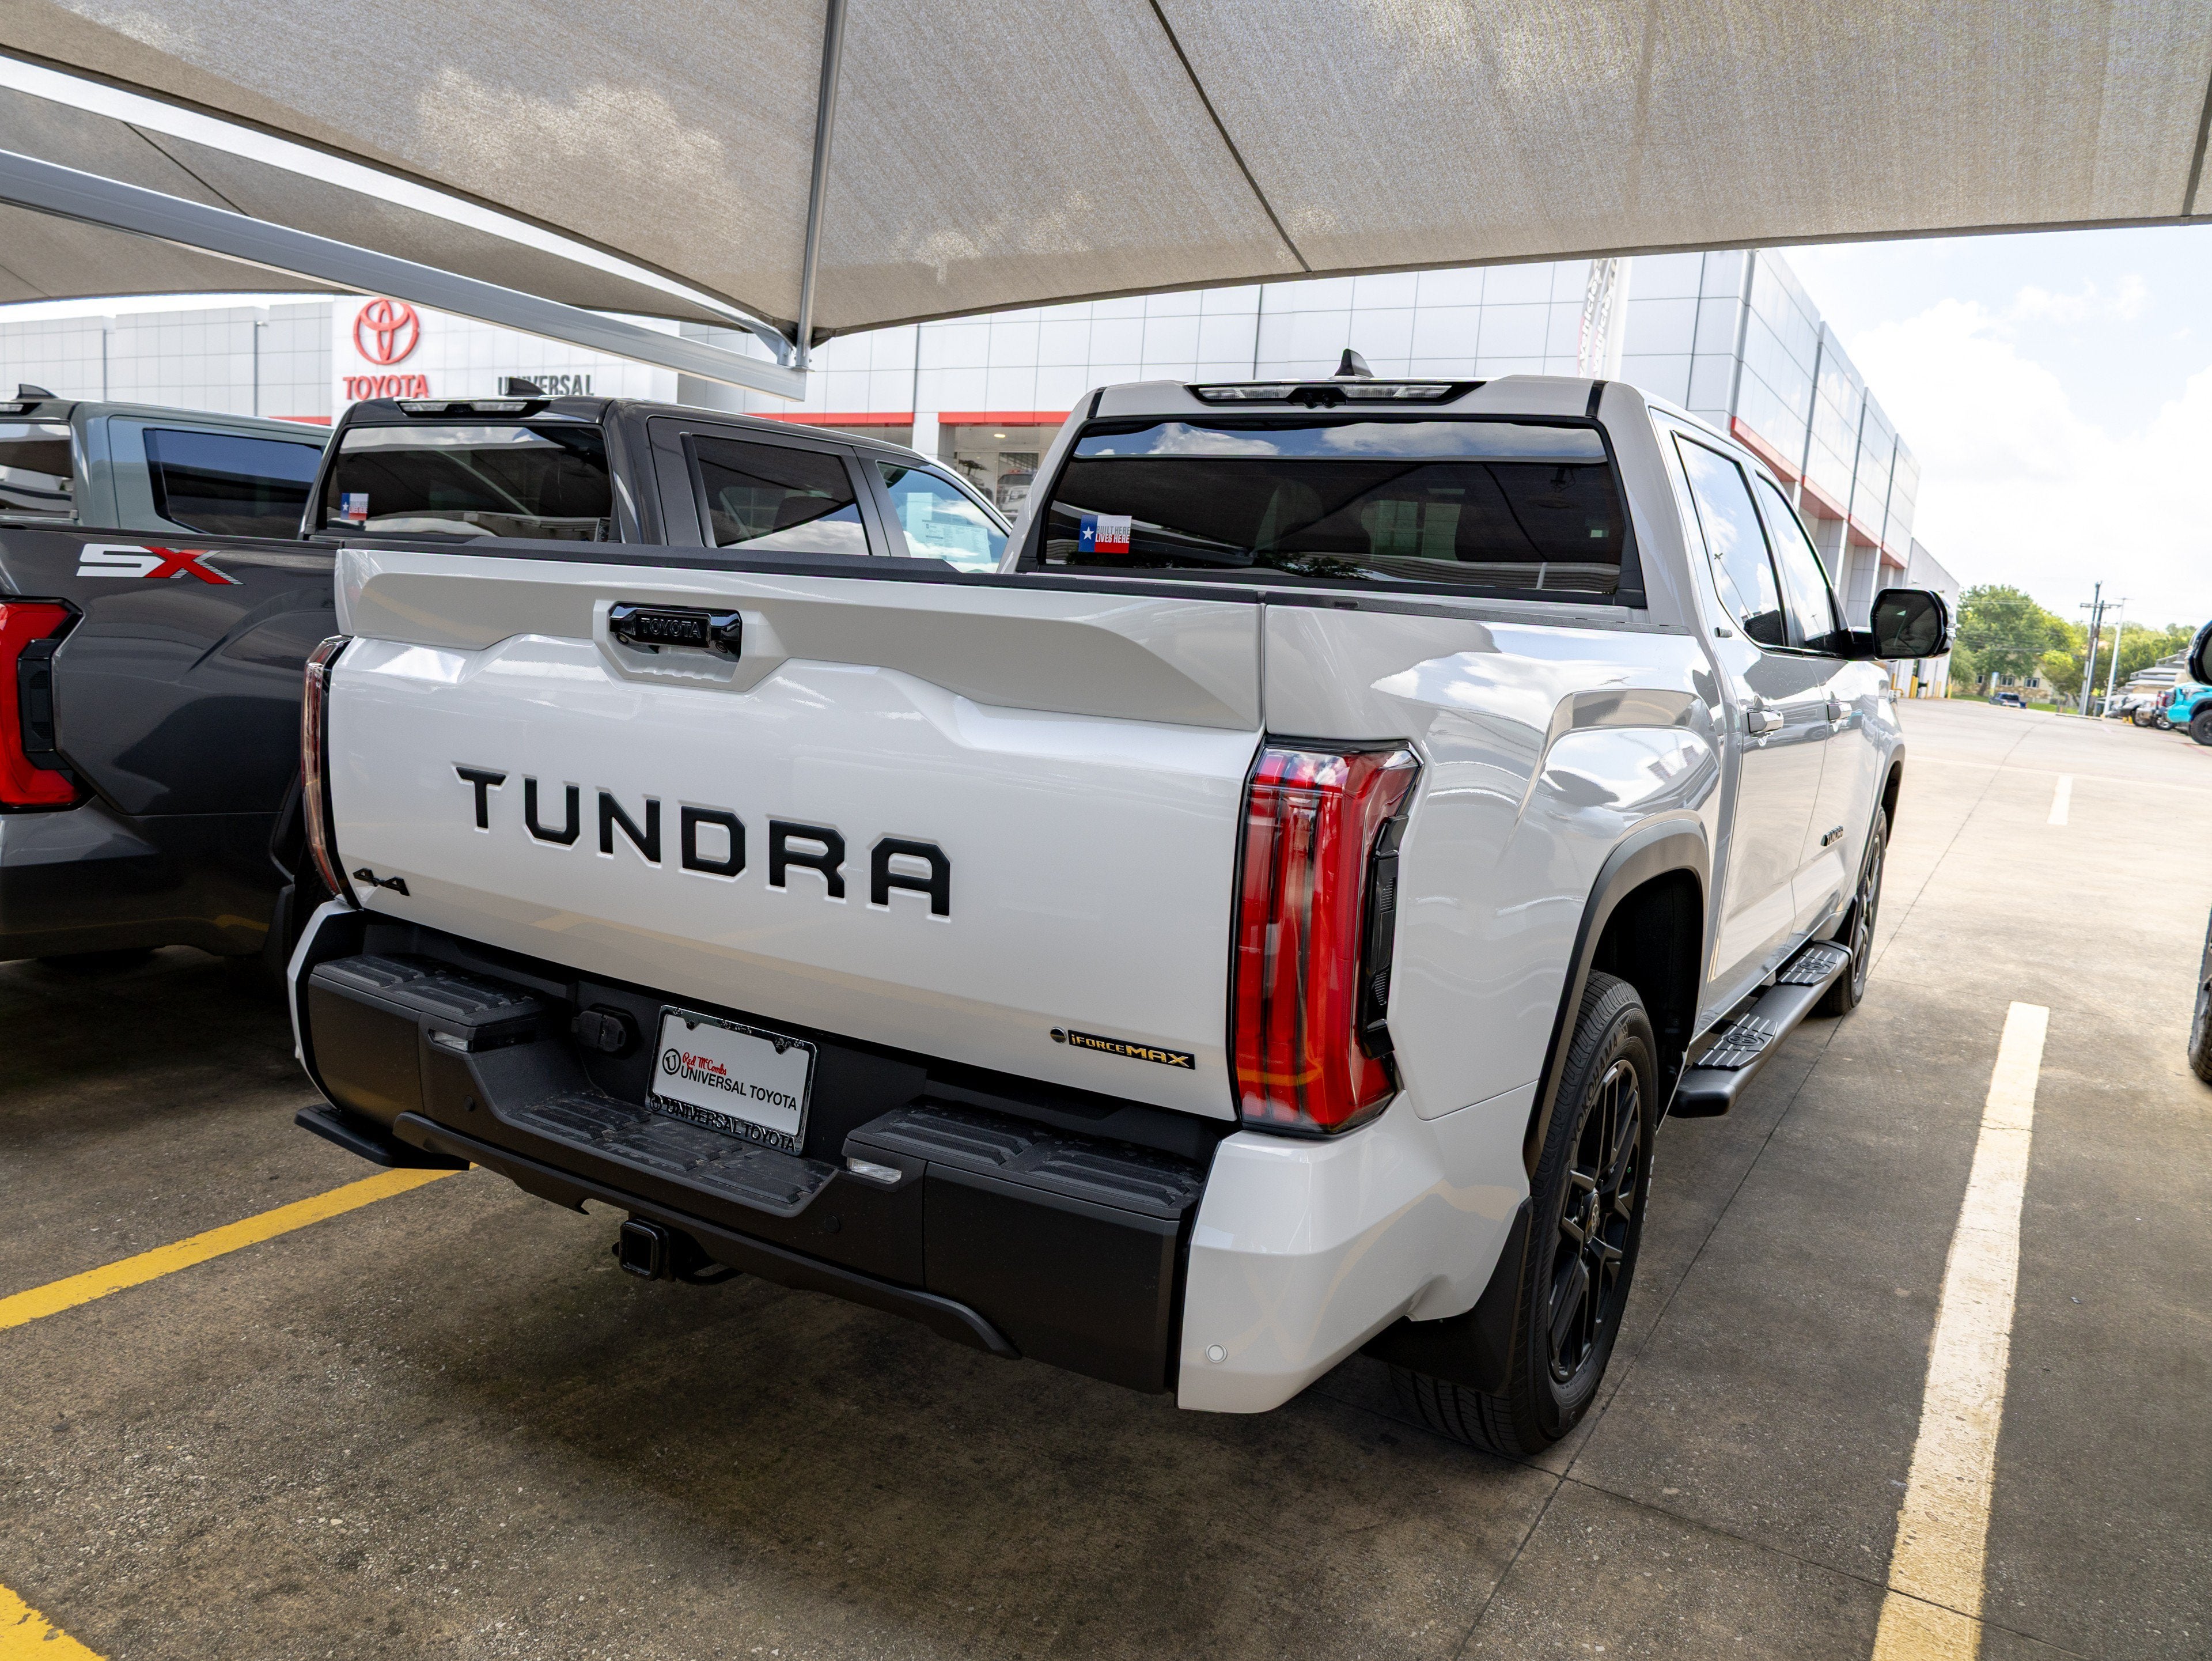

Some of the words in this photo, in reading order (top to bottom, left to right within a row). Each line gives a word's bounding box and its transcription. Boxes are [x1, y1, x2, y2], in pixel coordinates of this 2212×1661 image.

[343, 374, 429, 400] TOYOTA
[498, 374, 594, 396] UERSAL
[1095, 534, 1112, 543] LIVES
[1113, 534, 1130, 543] HERE
[1096, 525, 1113, 535] BUILT
[1115, 526, 1130, 535] HERE
[641, 618, 701, 638] TOYOTA
[454, 765, 951, 918] TUNDRA
[682, 1051, 696, 1070] Red
[698, 1056, 727, 1076] McCombs
[680, 1065, 747, 1096] UNIVERSAL
[749, 1084, 797, 1111] TOYOTA
[1570, 1032, 1618, 1142] YOKOHAMA
[666, 1099, 741, 1134] UNIVERSAL
[744, 1122, 796, 1152] TOYOTA
